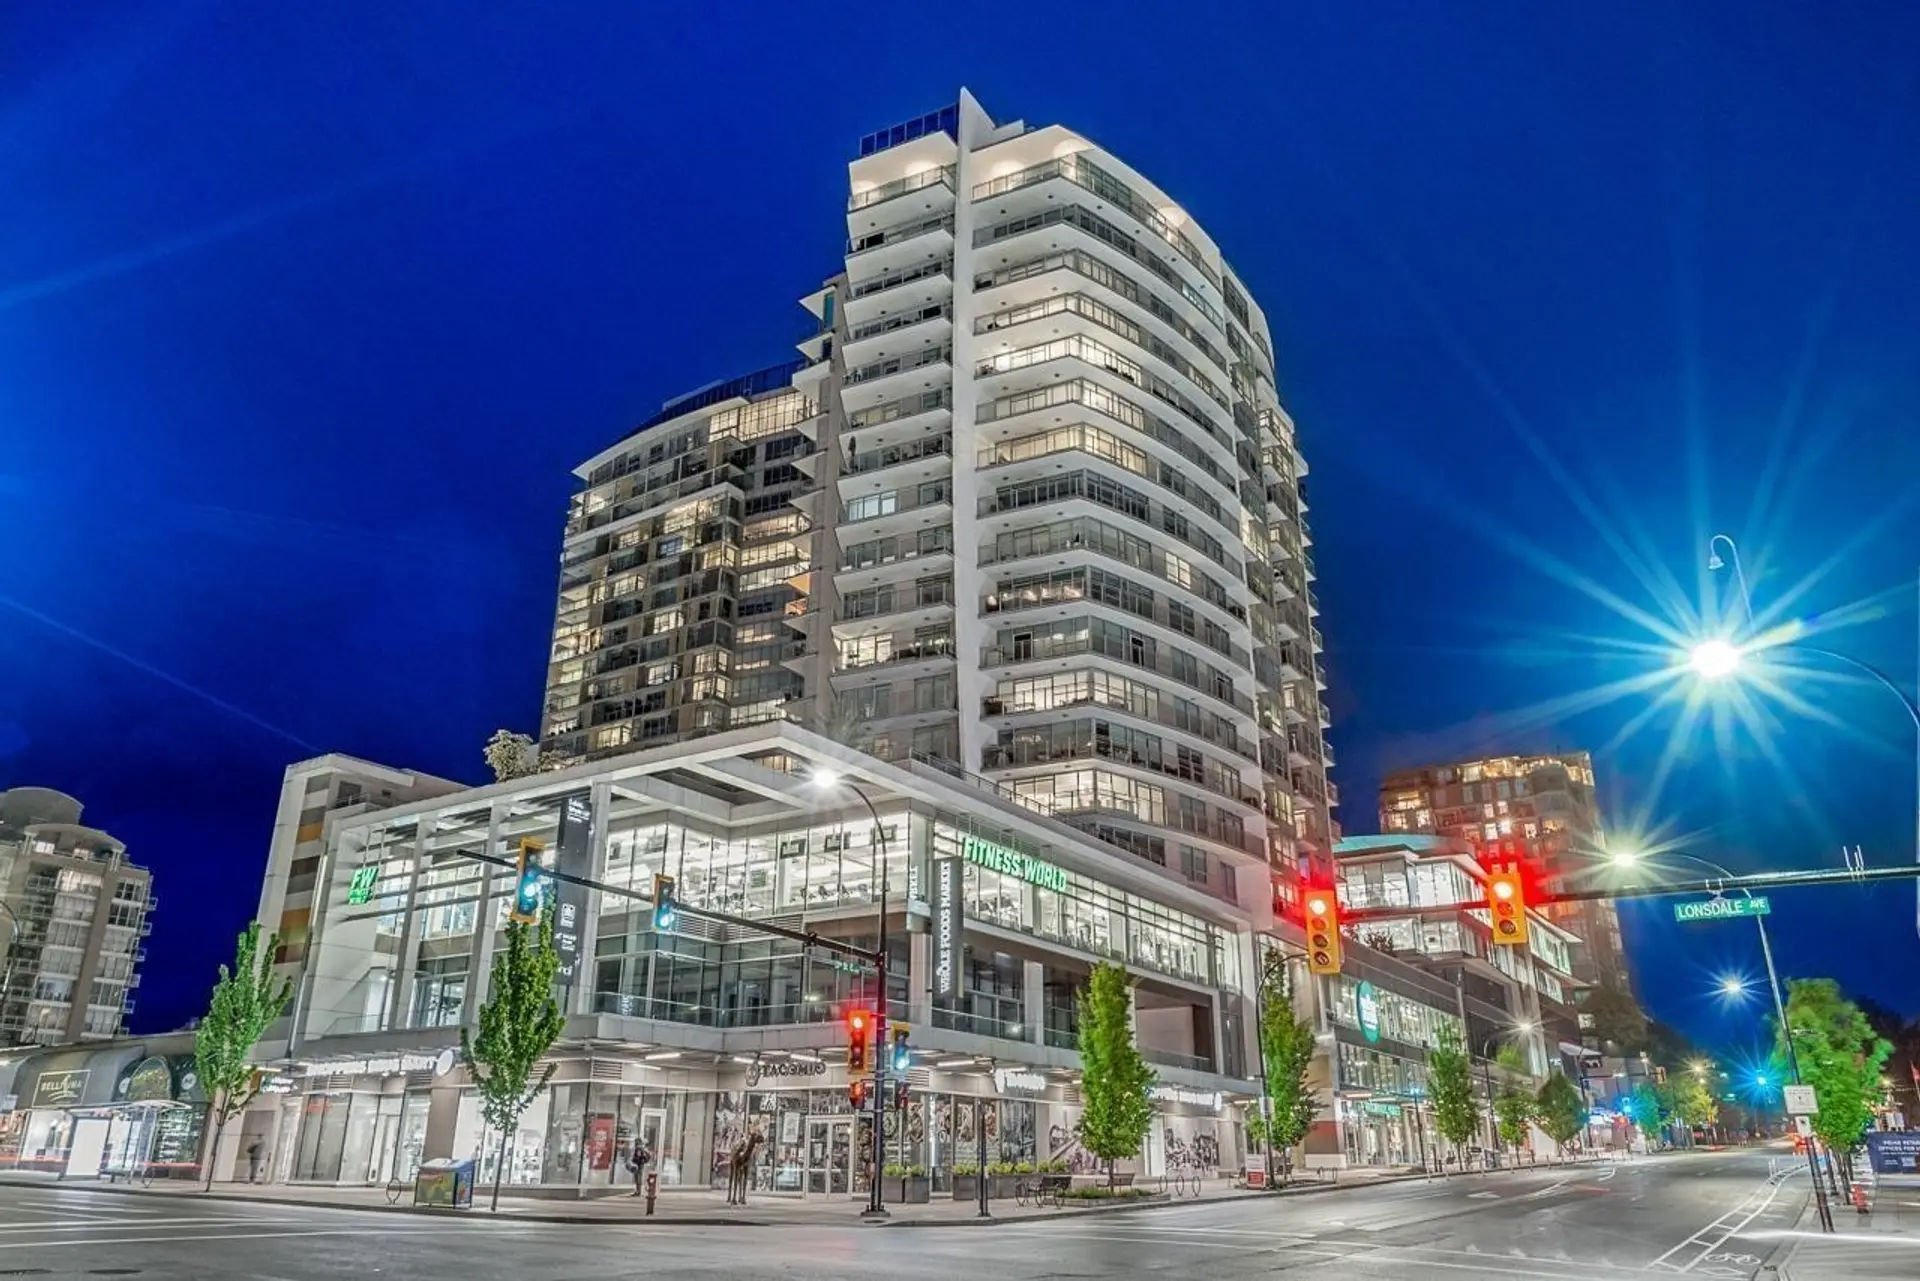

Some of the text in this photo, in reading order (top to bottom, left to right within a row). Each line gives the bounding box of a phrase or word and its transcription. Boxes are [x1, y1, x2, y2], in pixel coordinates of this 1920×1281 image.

[351, 867, 378, 889] FW
[964, 838, 1068, 892] FITNESS WORLD
[1678, 898, 1766, 918] LONSDALE AVE
[936, 861, 951, 994] WHOLE FOODS MARKET
